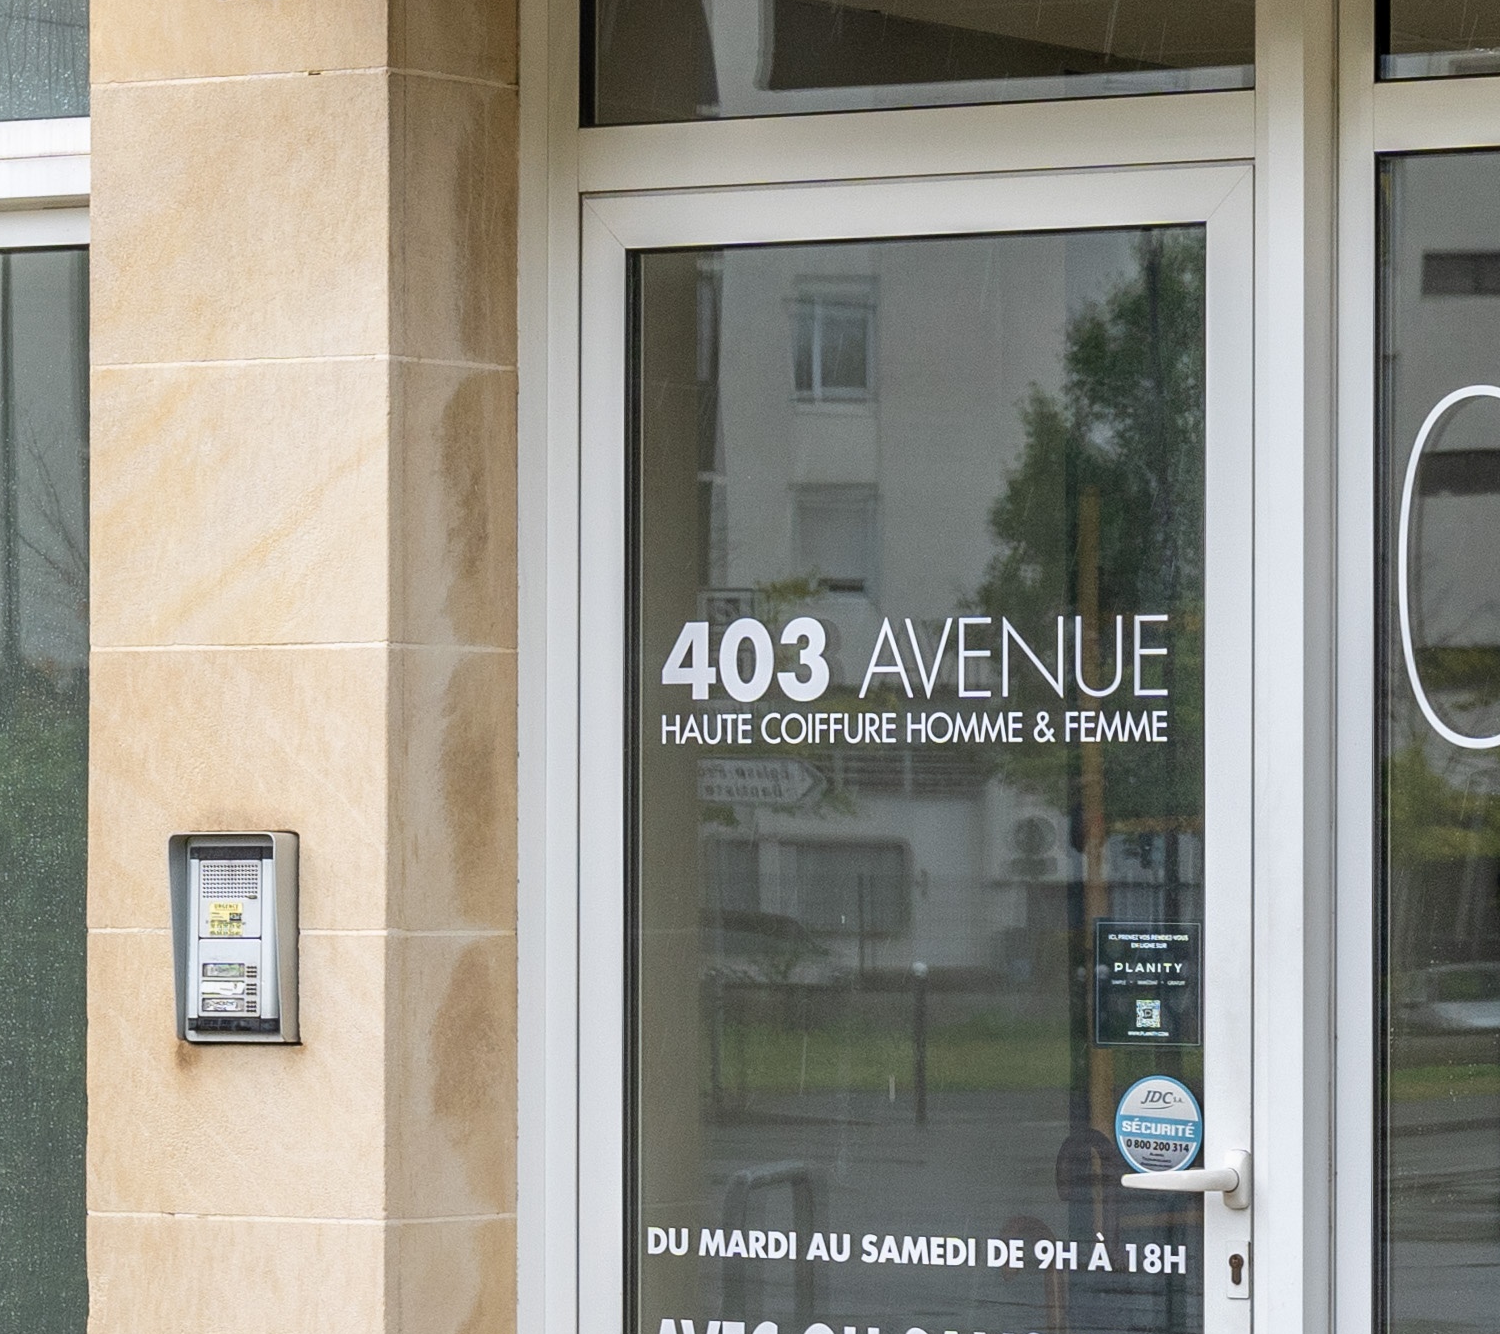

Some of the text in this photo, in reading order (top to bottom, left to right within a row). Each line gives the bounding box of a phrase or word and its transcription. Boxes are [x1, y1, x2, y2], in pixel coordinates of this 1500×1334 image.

[660, 613, 1170, 704] 403 AVENUE
[660, 709, 1169, 746] HAUTE COIFFURE HOMME & FEMME
[1114, 962, 1183, 973] PLANITY
[1140, 1090, 1173, 1105] JDC
[1121, 1118, 1195, 1138] SÉCURITÉ
[1126, 1138, 1190, 1153] 0 800 200 314
[646, 1225, 1187, 1275] DU MARDI AU SAMEDI DE 9H À 18H
